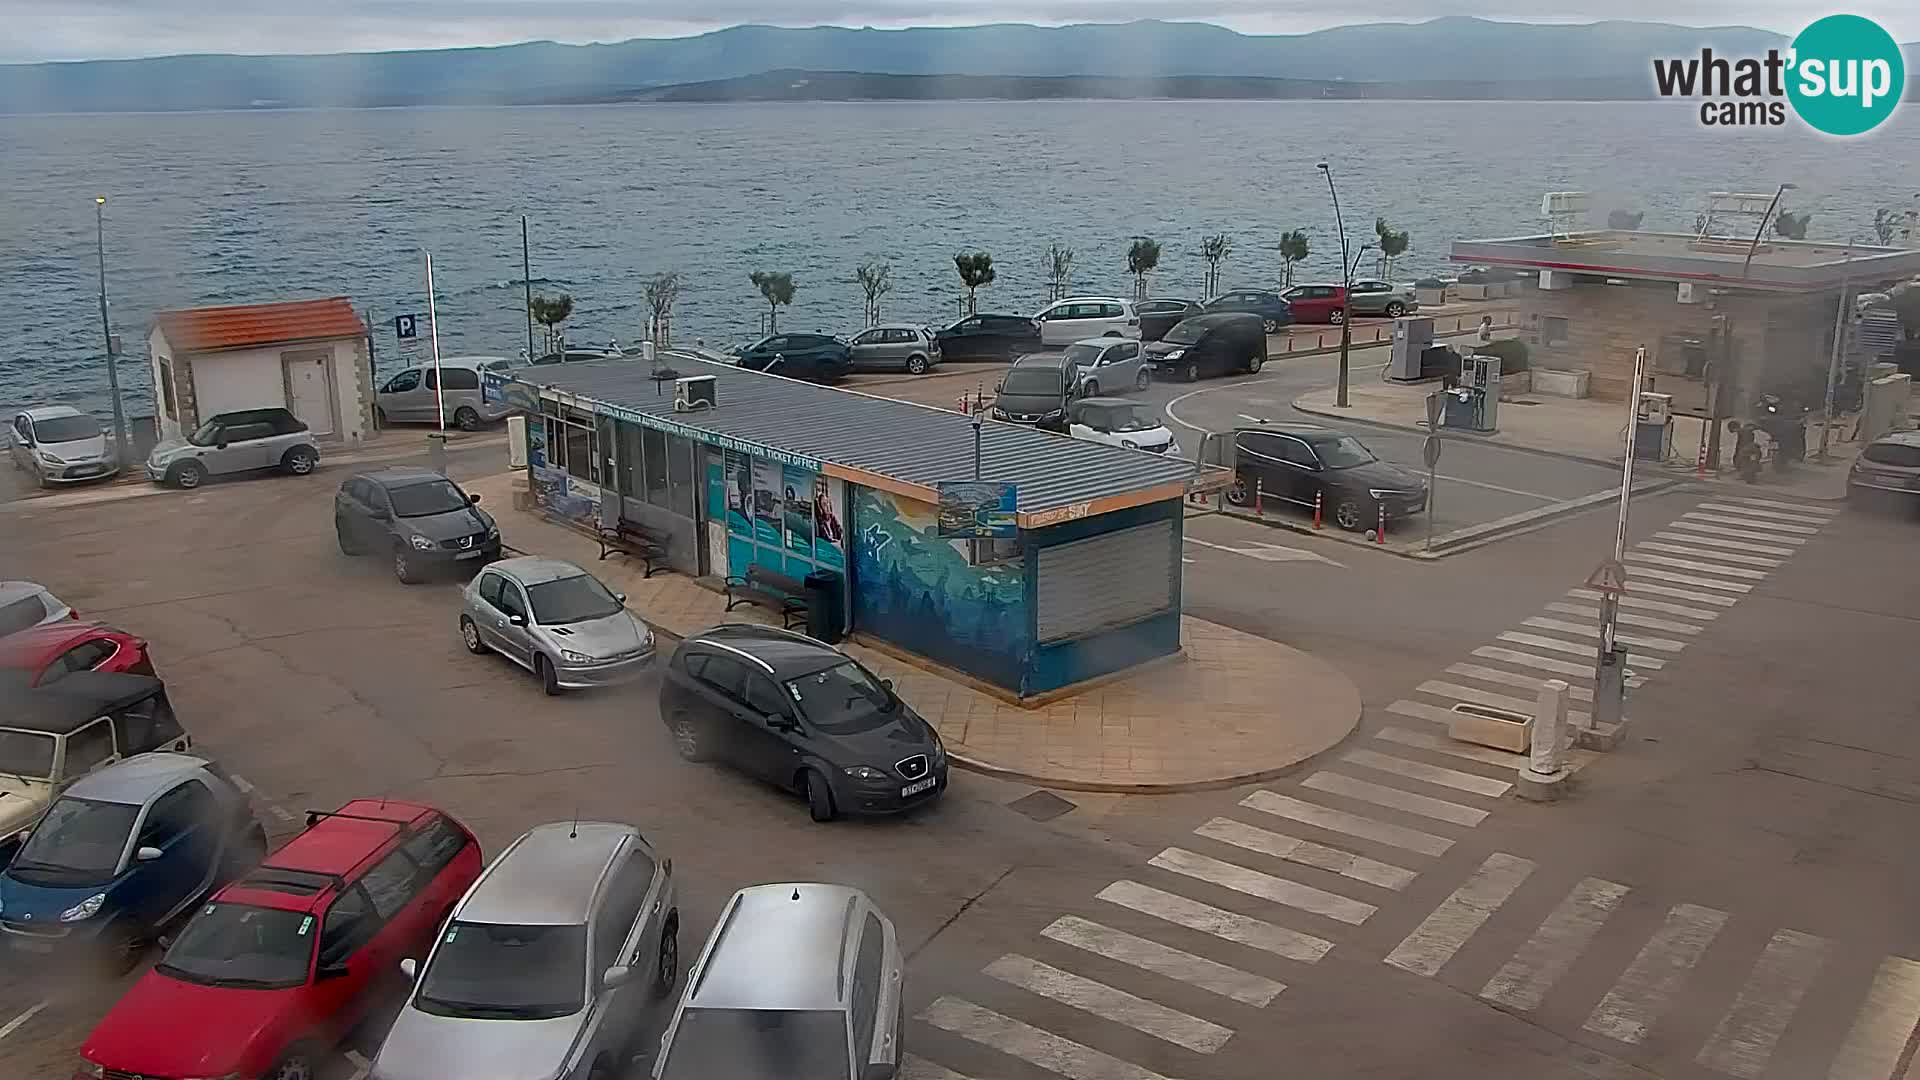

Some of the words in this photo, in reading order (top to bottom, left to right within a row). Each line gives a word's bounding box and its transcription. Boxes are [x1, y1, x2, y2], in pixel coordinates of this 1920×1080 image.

[400, 317, 411, 336] P
[719, 436, 733, 449] BUS
[734, 440, 764, 457] STATION
[766, 448, 791, 463] TICKET
[791, 455, 819, 470] OFFICE
